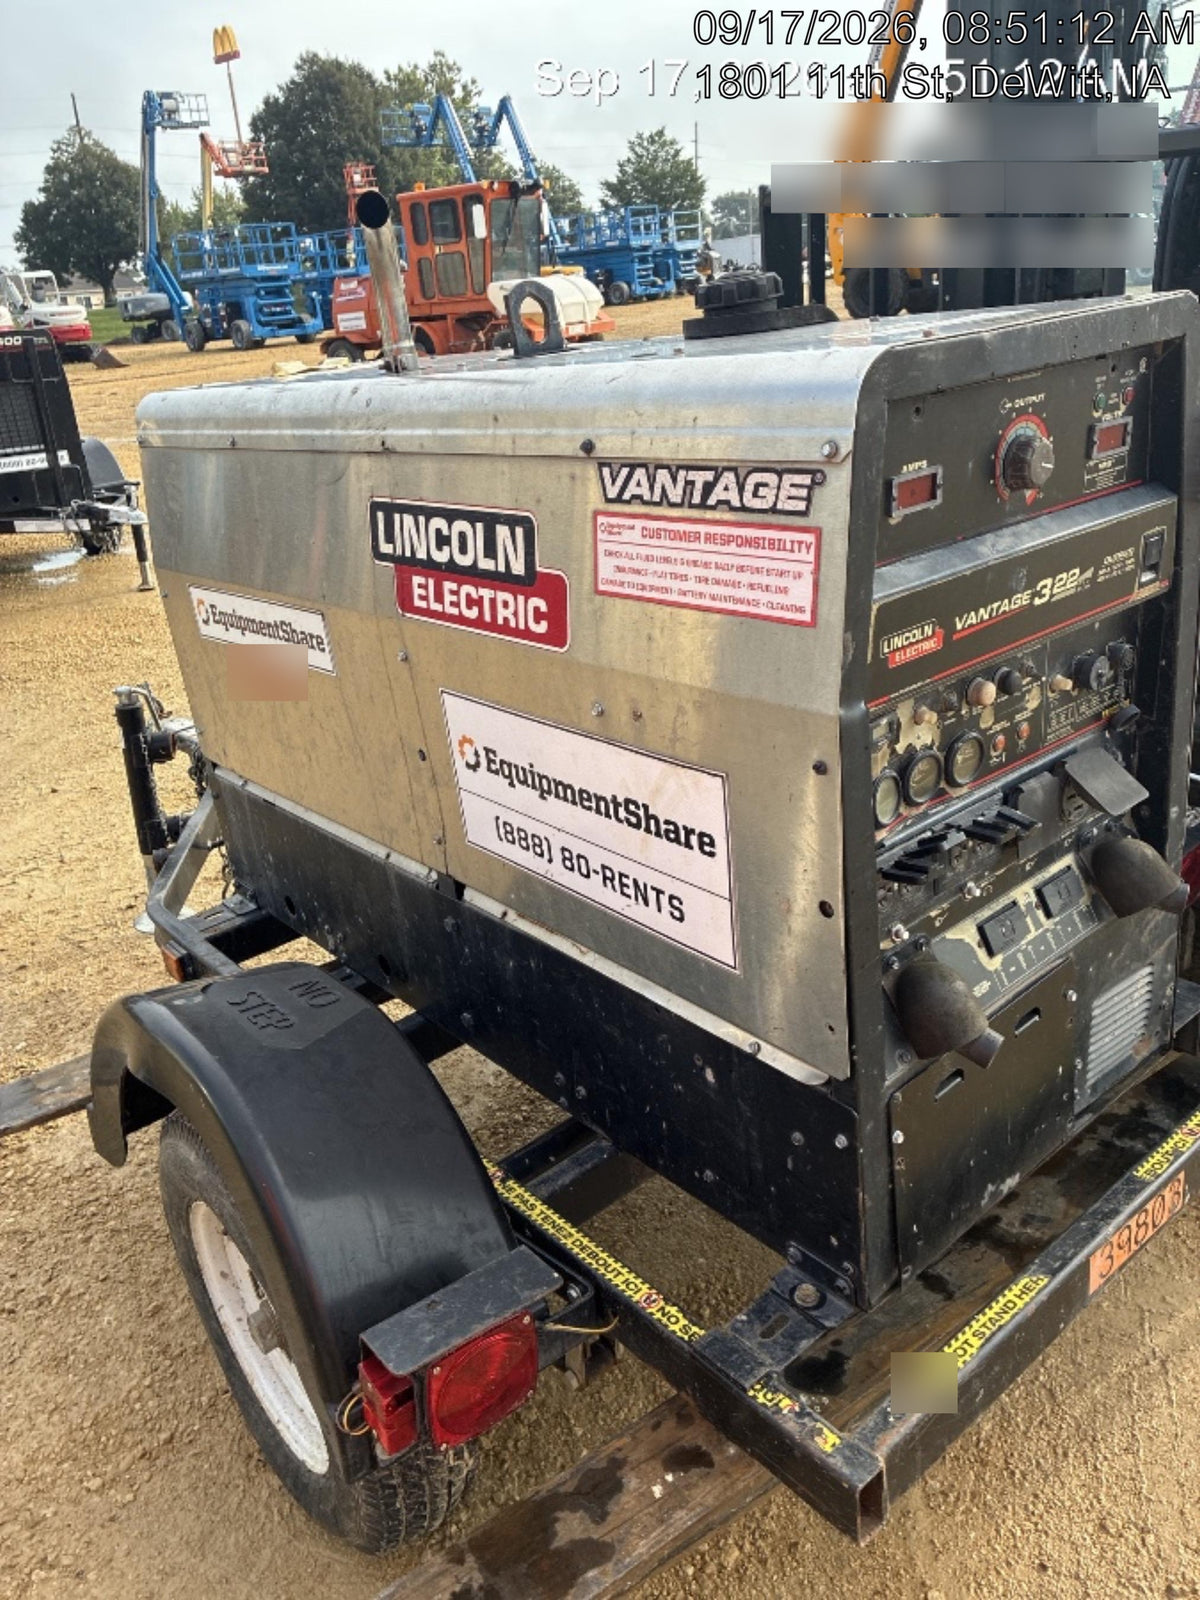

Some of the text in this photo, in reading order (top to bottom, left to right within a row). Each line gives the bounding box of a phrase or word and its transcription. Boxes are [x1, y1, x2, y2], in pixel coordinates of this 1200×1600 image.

[375, 510, 527, 577] LINCOLN
[641, 526, 702, 545] CUSTOMER
[703, 531, 814, 555] RESPONSIBILITY
[411, 574, 549, 634] ELECTRIC
[954, 588, 1032, 631] VANTAGE
[1033, 567, 1081, 606] 322
[208, 603, 327, 653] EquipmentShare
[883, 623, 933, 653] LINCOLN
[895, 636, 939, 662] ELECTRIC
[483, 746, 717, 859] EquipmentShare
[495, 815, 686, 924] (888) 80-RENTS
[226, 991, 296, 1031] STEP
[288, 980, 341, 1009] NO
[515, 1193, 538, 1212] PAS
[571, 1238, 625, 1279] DEBOUT
[620, 1278, 643, 1295] ICI
[656, 1307, 681, 1326] NO
[971, 1299, 1018, 1341] STAND
